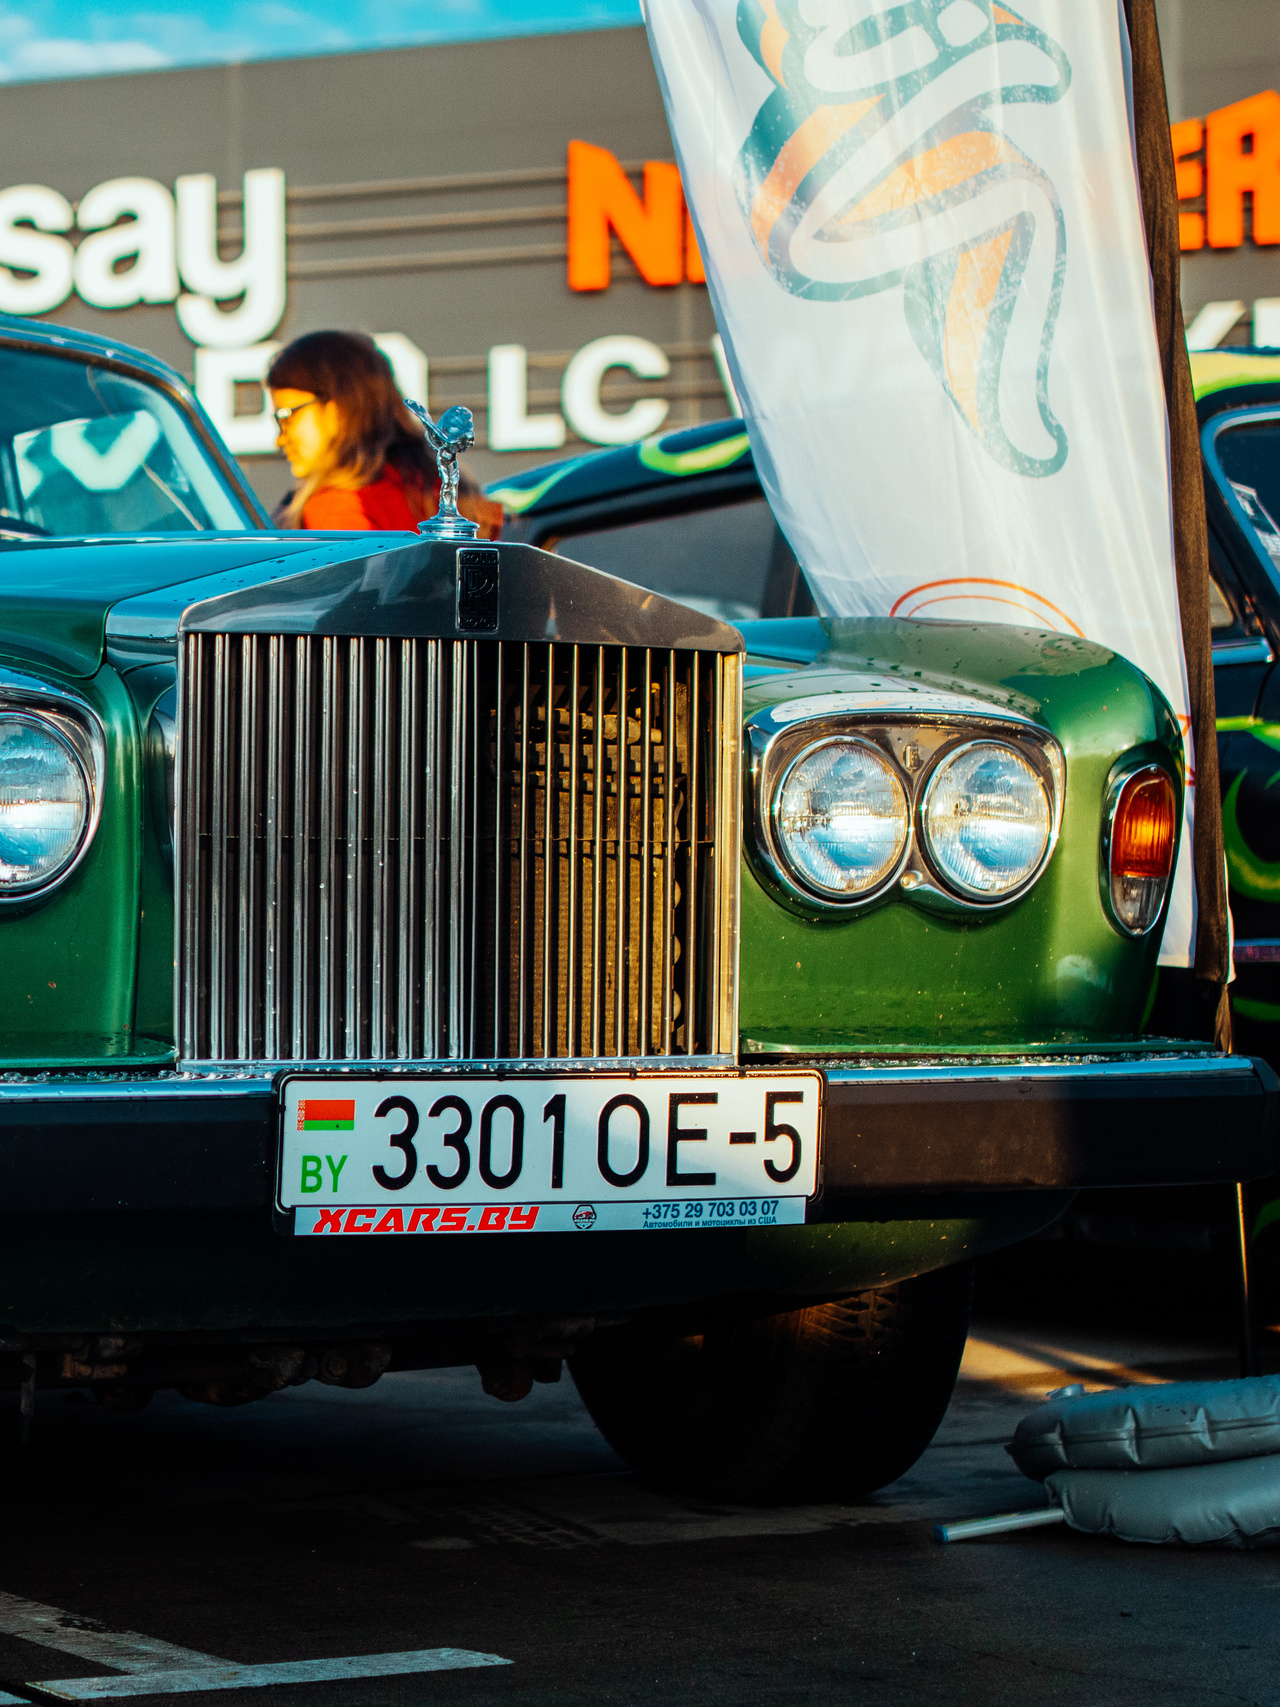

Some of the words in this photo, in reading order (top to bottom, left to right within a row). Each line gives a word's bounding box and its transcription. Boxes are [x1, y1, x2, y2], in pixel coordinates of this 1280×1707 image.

[300, 1155, 348, 1193] BY
[312, 1206, 540, 1233] XCARS.BY
[642, 1204, 680, 1220] +375
[684, 1203, 704, 1218] 29
[708, 1202, 735, 1217] 703
[739, 1201, 758, 1217] 03
[761, 1200, 780, 1216] 07
[643, 1219, 693, 1228] Автомобили
[702, 1219, 745, 1227] мотоциклы
[758, 1217, 777, 1225] США
